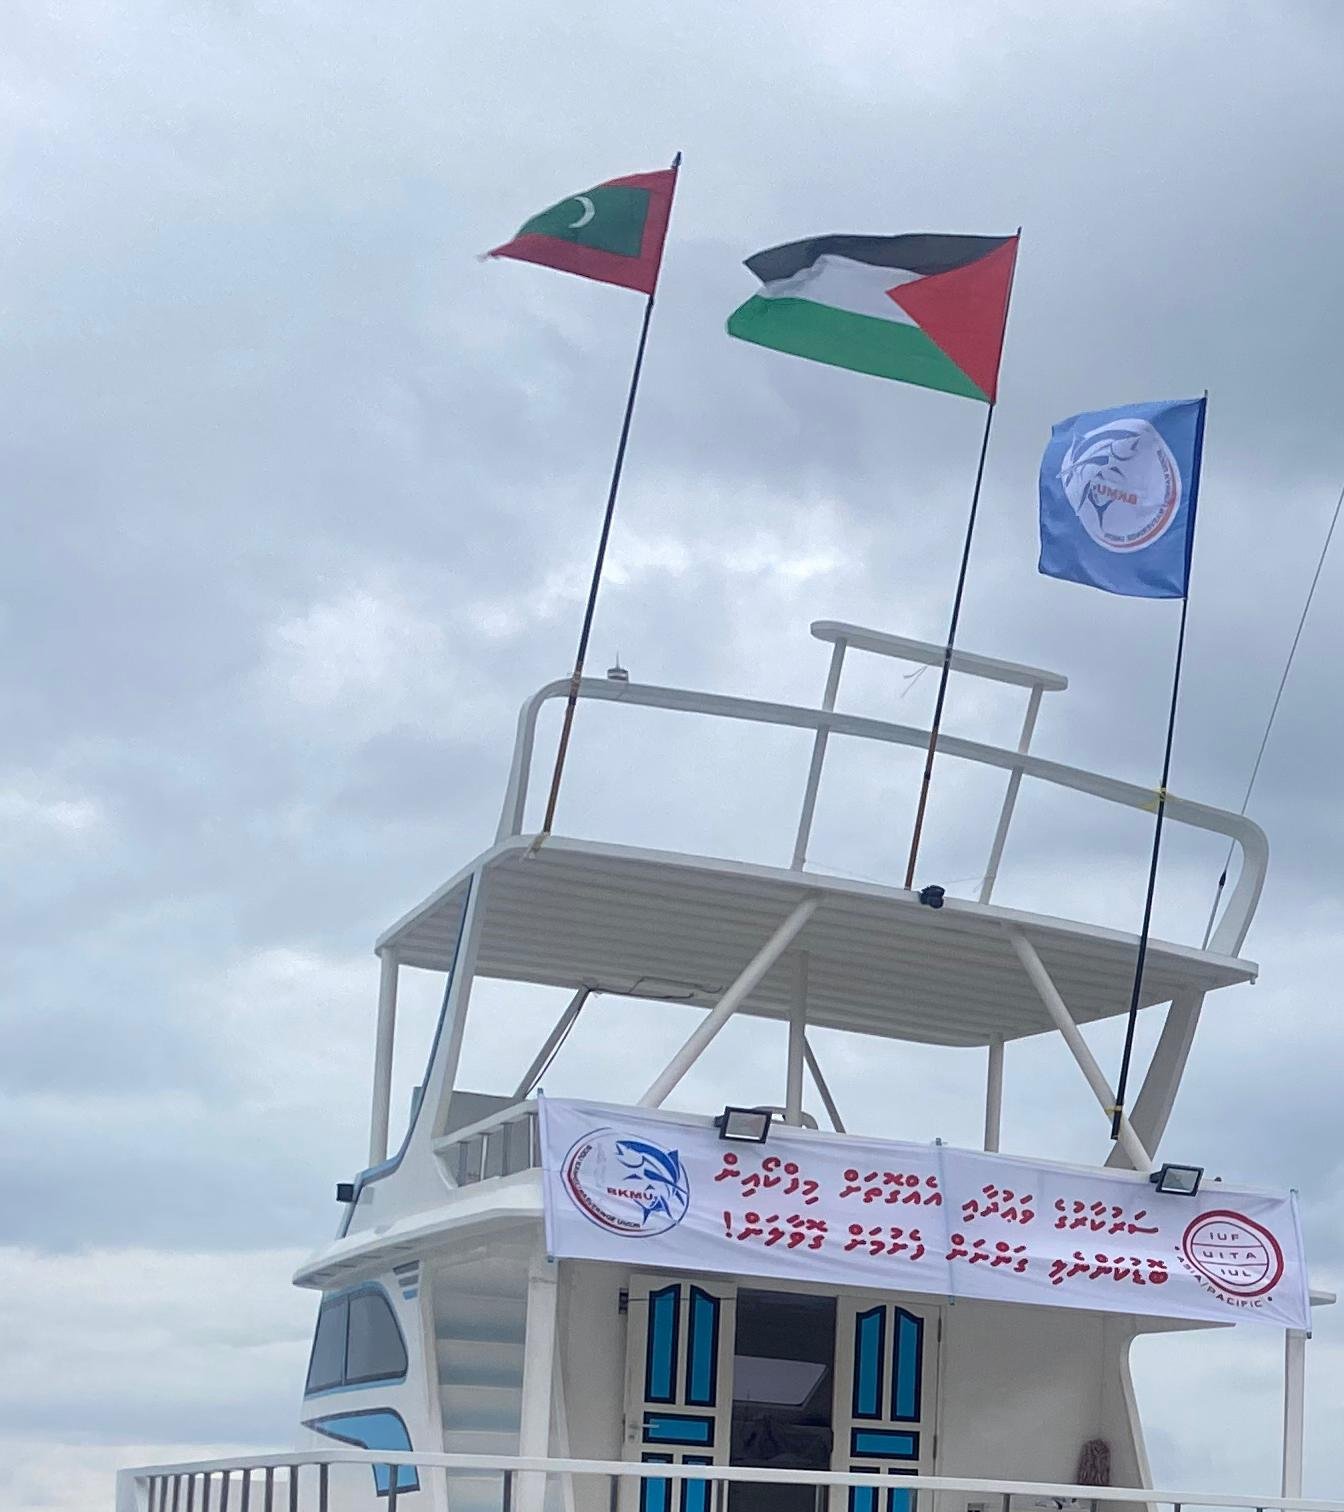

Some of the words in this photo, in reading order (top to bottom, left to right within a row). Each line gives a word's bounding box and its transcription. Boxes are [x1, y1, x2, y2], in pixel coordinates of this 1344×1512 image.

[607, 1187, 653, 1200] BKMU
[1209, 1232, 1239, 1241] IUF
[1202, 1250, 1257, 1259] UITA
[1220, 1268, 1252, 1277] IUL
